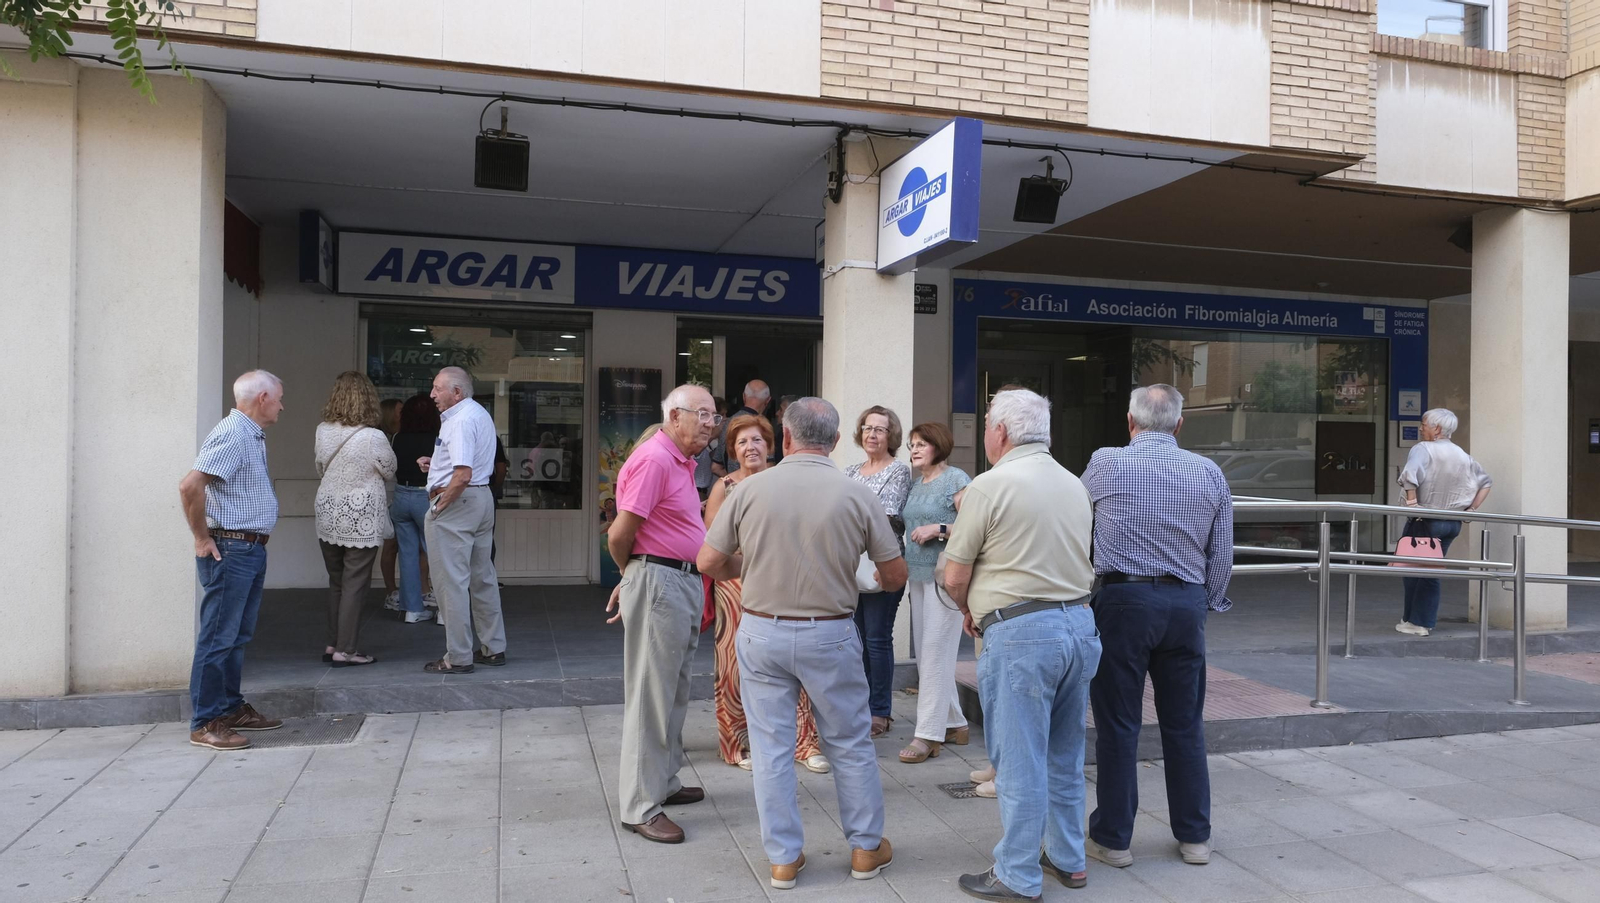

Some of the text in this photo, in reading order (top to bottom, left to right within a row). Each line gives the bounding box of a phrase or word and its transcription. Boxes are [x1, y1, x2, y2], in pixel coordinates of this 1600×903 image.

[885, 178, 942, 224] ARGAR VIAJES
[364, 247, 790, 303] ARGAR VIAJES
[955, 285, 975, 303] 76
[1021, 293, 1338, 328] afial Asociación Fibromialgia Almería
[1394, 310, 1426, 319] SÍNDROME
[1394, 327, 1422, 336] CRÓNICA
[1403, 320, 1425, 328] FATIGA
[387, 349, 466, 366] ARGAR
